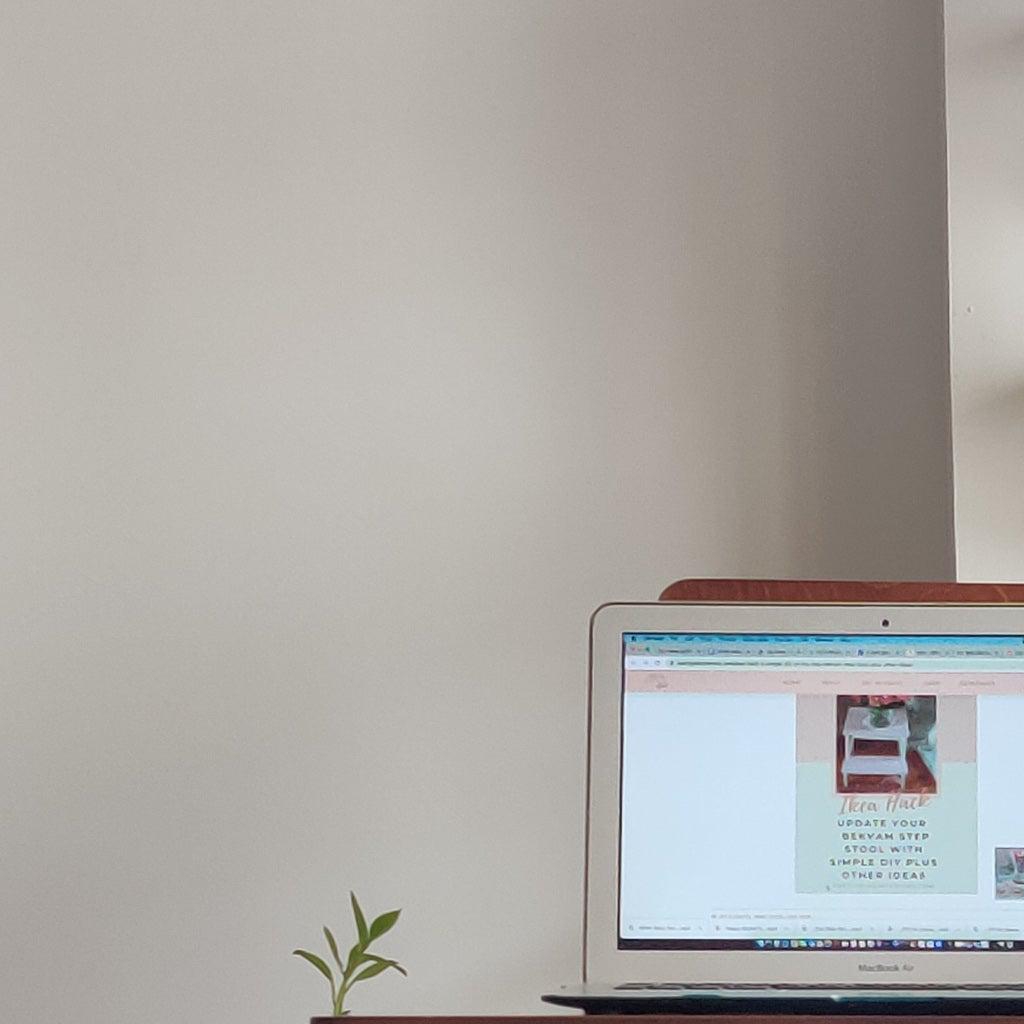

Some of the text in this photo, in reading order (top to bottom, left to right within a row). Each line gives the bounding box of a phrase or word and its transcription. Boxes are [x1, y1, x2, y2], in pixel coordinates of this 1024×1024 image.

[839, 787, 932, 815] Ikea Hack
[837, 819, 927, 828] UPDATE YOUR
[898, 832, 930, 841] STEP
[844, 845, 923, 854] STOOL WITH
[829, 858, 938, 867] SIMPLE DIY PLUS
[841, 871, 926, 880] OTHER IDEAS
[858, 963, 899, 972] MacBook
